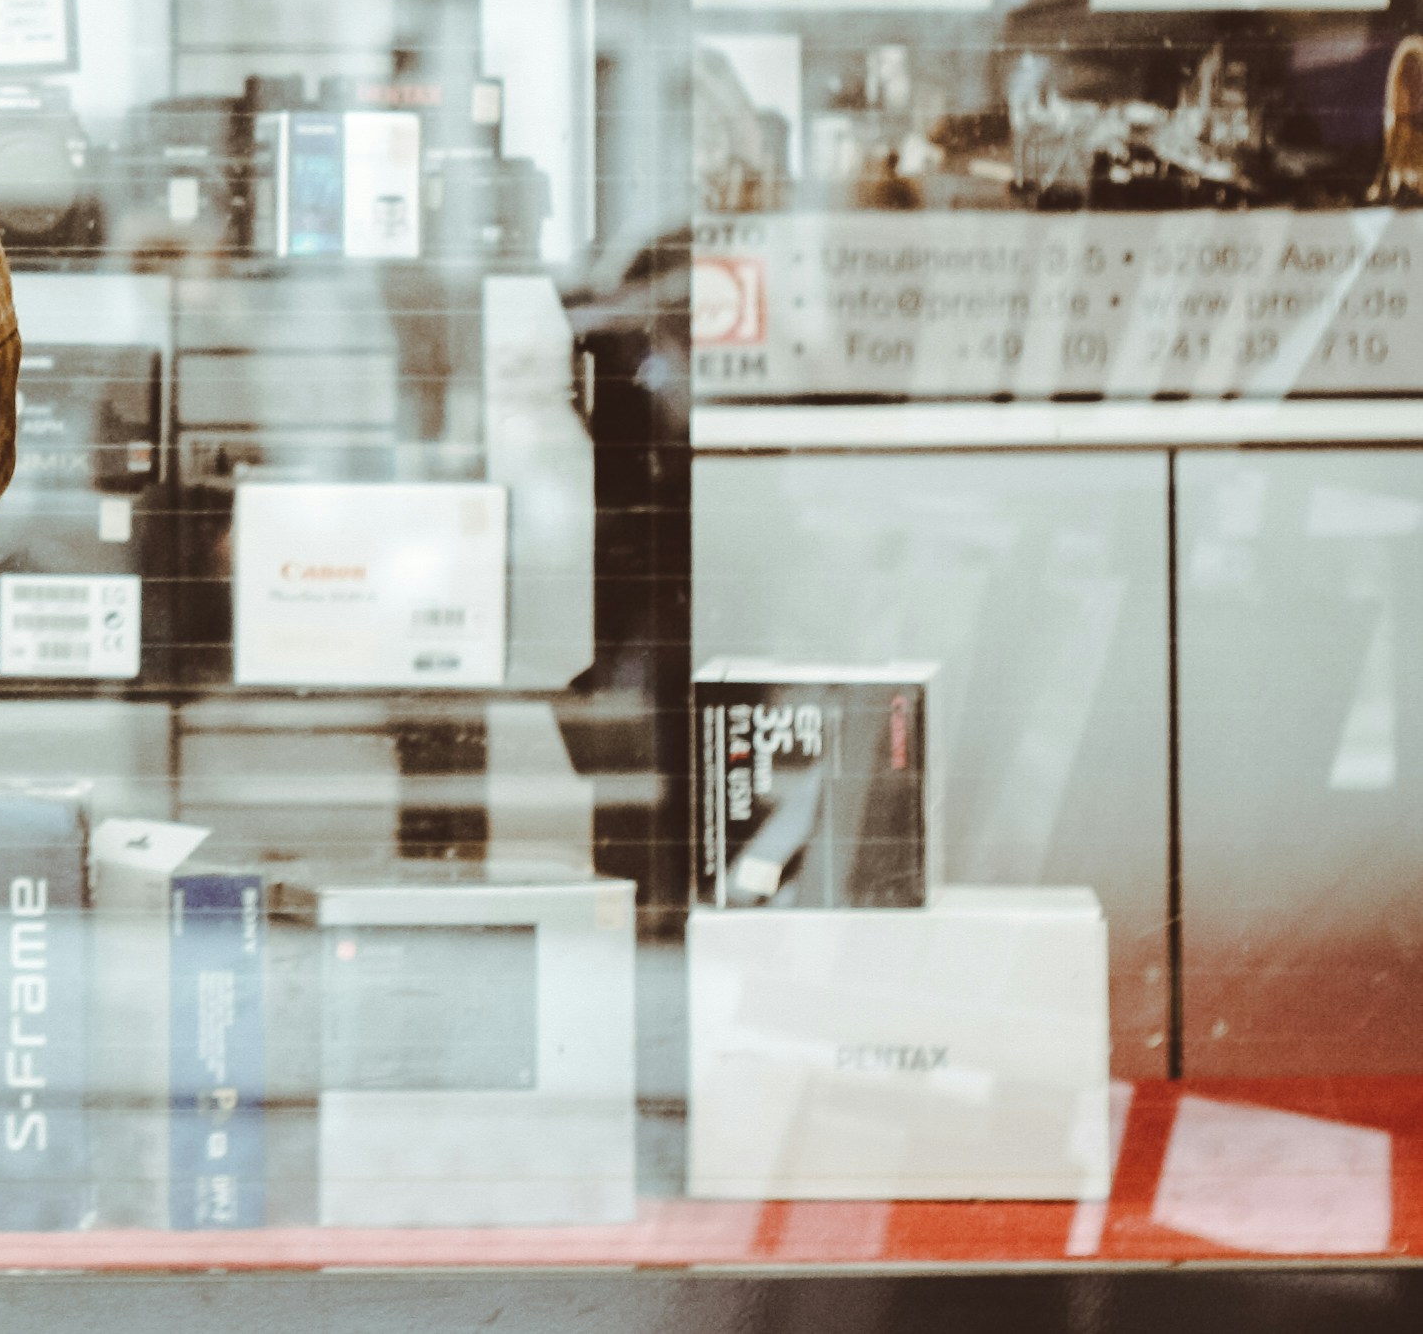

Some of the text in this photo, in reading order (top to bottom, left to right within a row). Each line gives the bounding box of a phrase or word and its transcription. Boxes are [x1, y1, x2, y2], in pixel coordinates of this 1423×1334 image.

[279, 561, 368, 581] Canon
[794, 704, 824, 757] EF
[4, 875, 49, 1152] S-Frame
[835, 1046, 950, 1072] PENTAX
